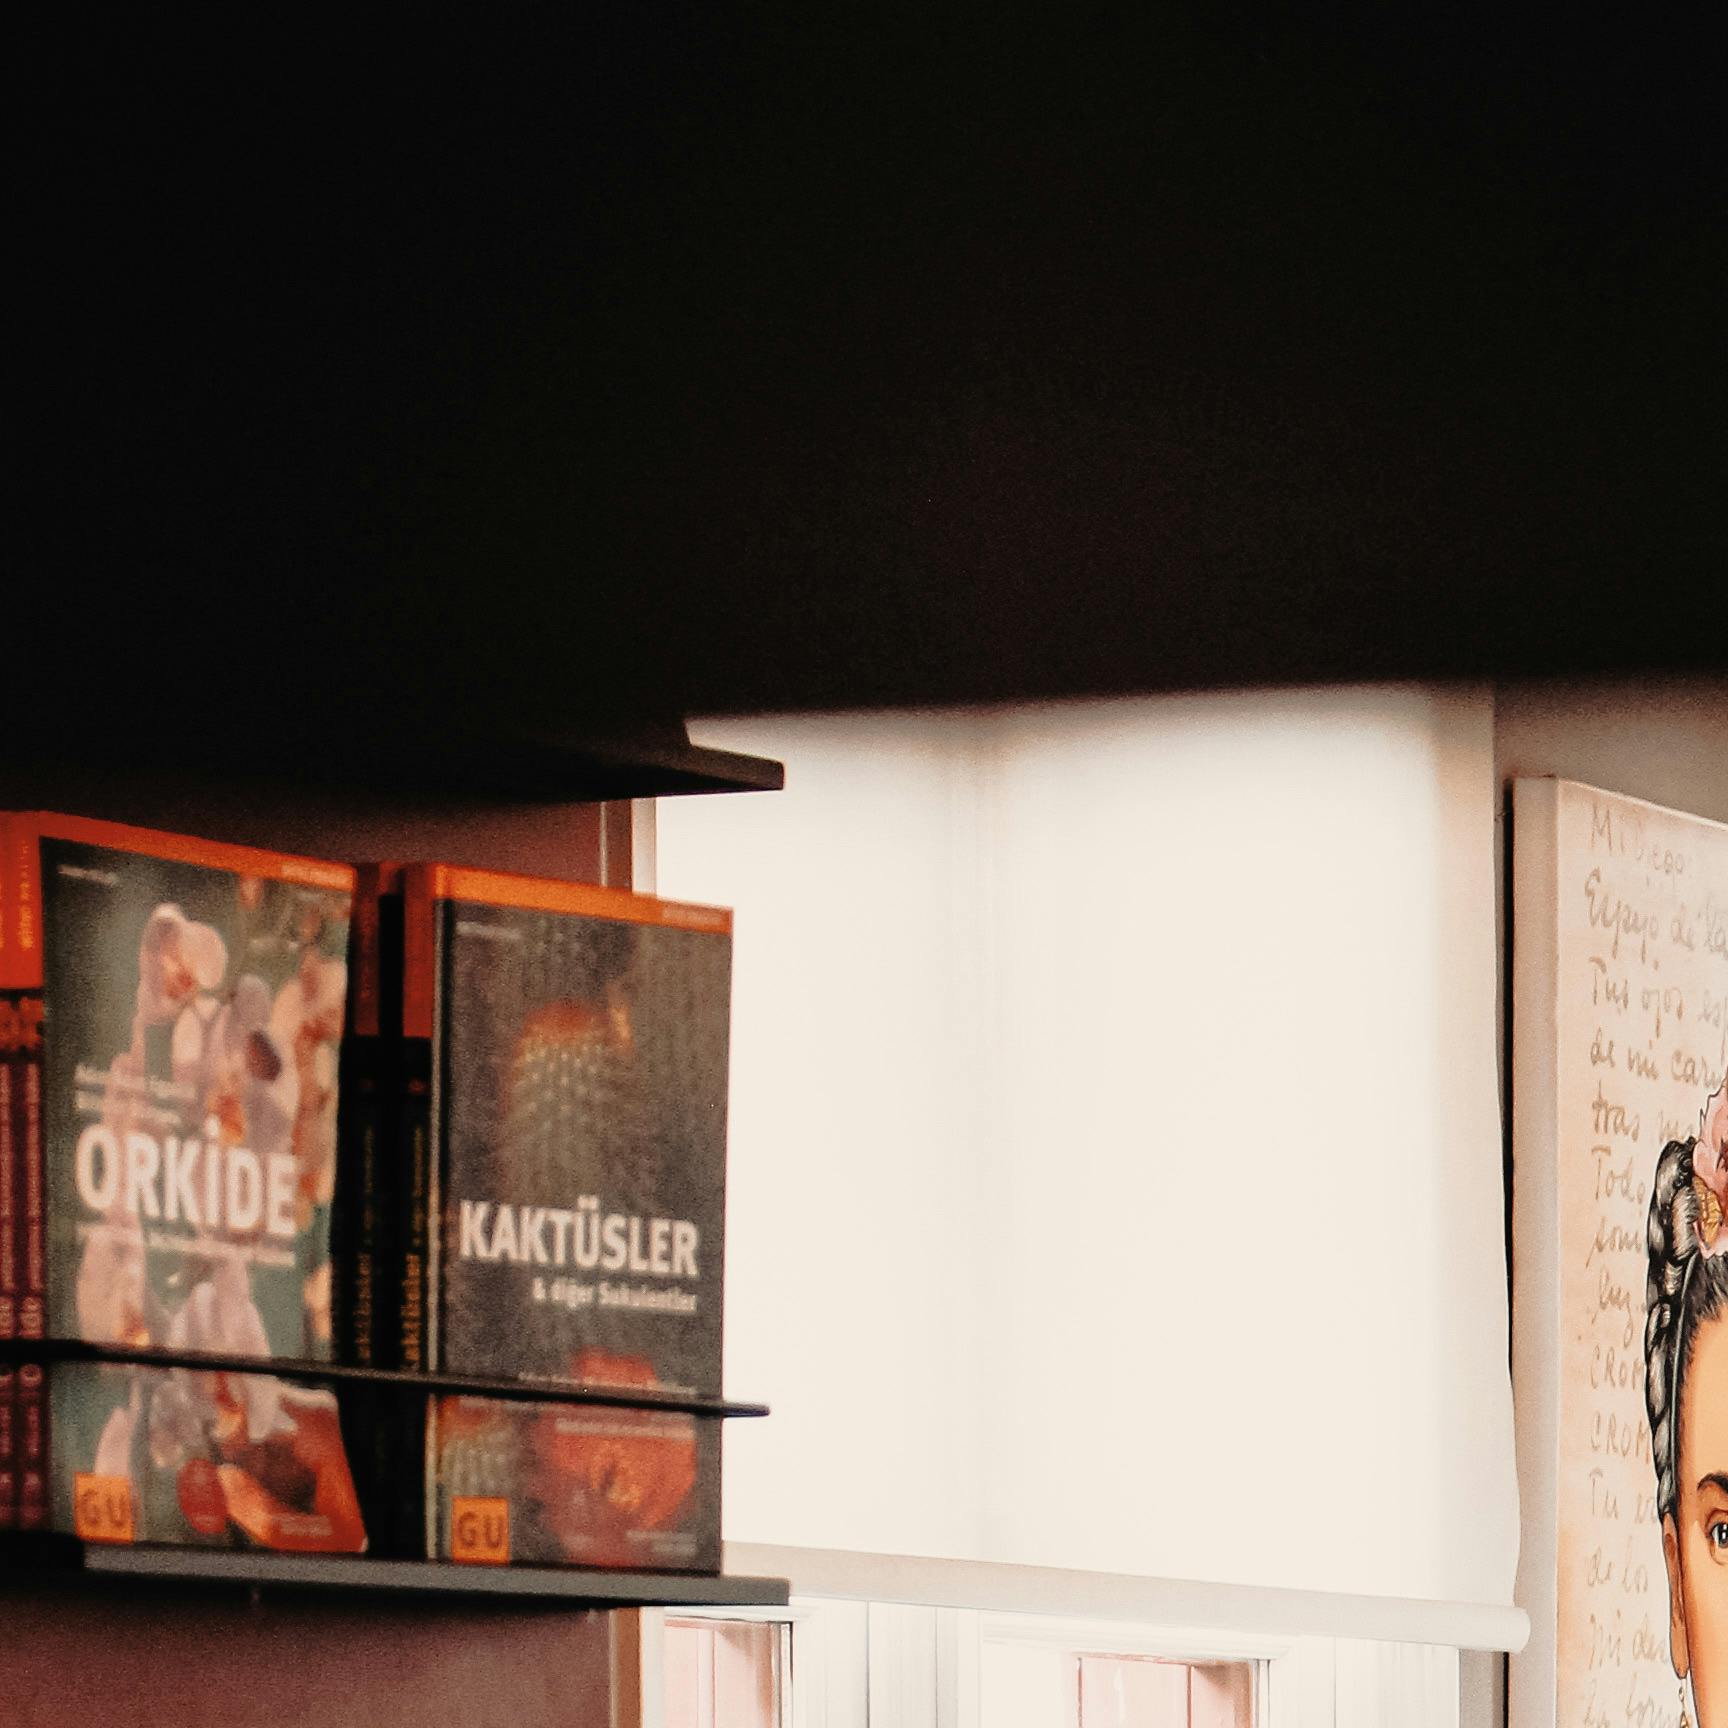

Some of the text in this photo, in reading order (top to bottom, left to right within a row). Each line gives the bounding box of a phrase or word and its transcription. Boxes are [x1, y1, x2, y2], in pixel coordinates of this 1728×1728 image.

[76, 1114, 298, 1235] ORKİDE
[460, 1194, 700, 1277] KAKTÜSLER
[81, 1488, 126, 1527] GU
[457, 1511, 503, 1549] GU
